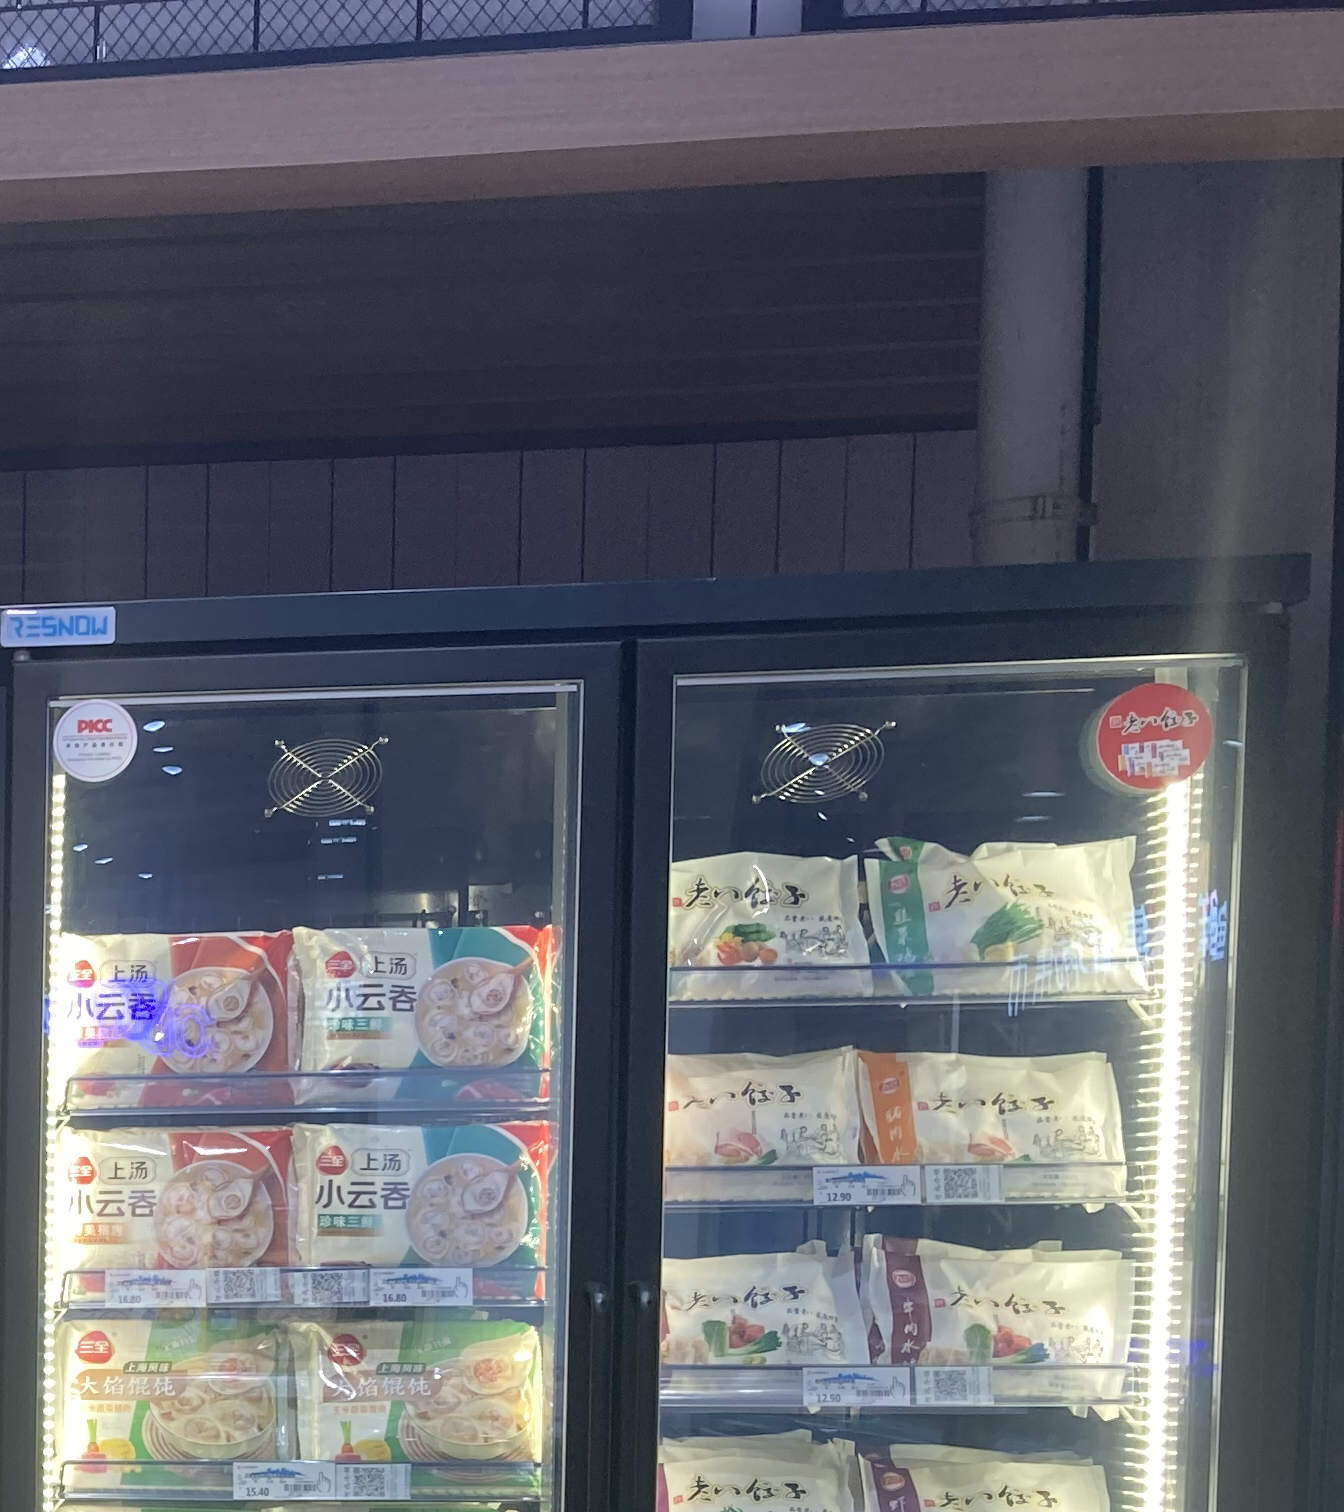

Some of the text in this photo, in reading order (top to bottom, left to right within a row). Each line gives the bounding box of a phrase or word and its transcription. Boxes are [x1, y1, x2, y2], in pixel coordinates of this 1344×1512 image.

[9, 615, 108, 638] RESNOW
[77, 719, 113, 733] PICC
[326, 958, 353, 972] 三全
[371, 955, 408, 977] 上汤
[110, 963, 149, 984] 上汤
[326, 984, 419, 1013] 小云吞
[319, 1155, 347, 1168] 三全
[360, 1153, 404, 1174] 上汤
[108, 1161, 149, 1182] 上汤
[315, 1181, 411, 1212] 小云吞
[827, 1192, 852, 1202] 12.90
[67, 1190, 158, 1218] 小云吞
[383, 1293, 407, 1303] 16.80
[78, 1341, 111, 1355] 三全
[123, 1361, 173, 1375] 上海风味
[377, 1362, 427, 1375] 上海风味
[80, 1377, 177, 1396] 大馅馄饨
[816, 1394, 841, 1403] 12.90
[246, 1487, 270, 1497] 15.40
